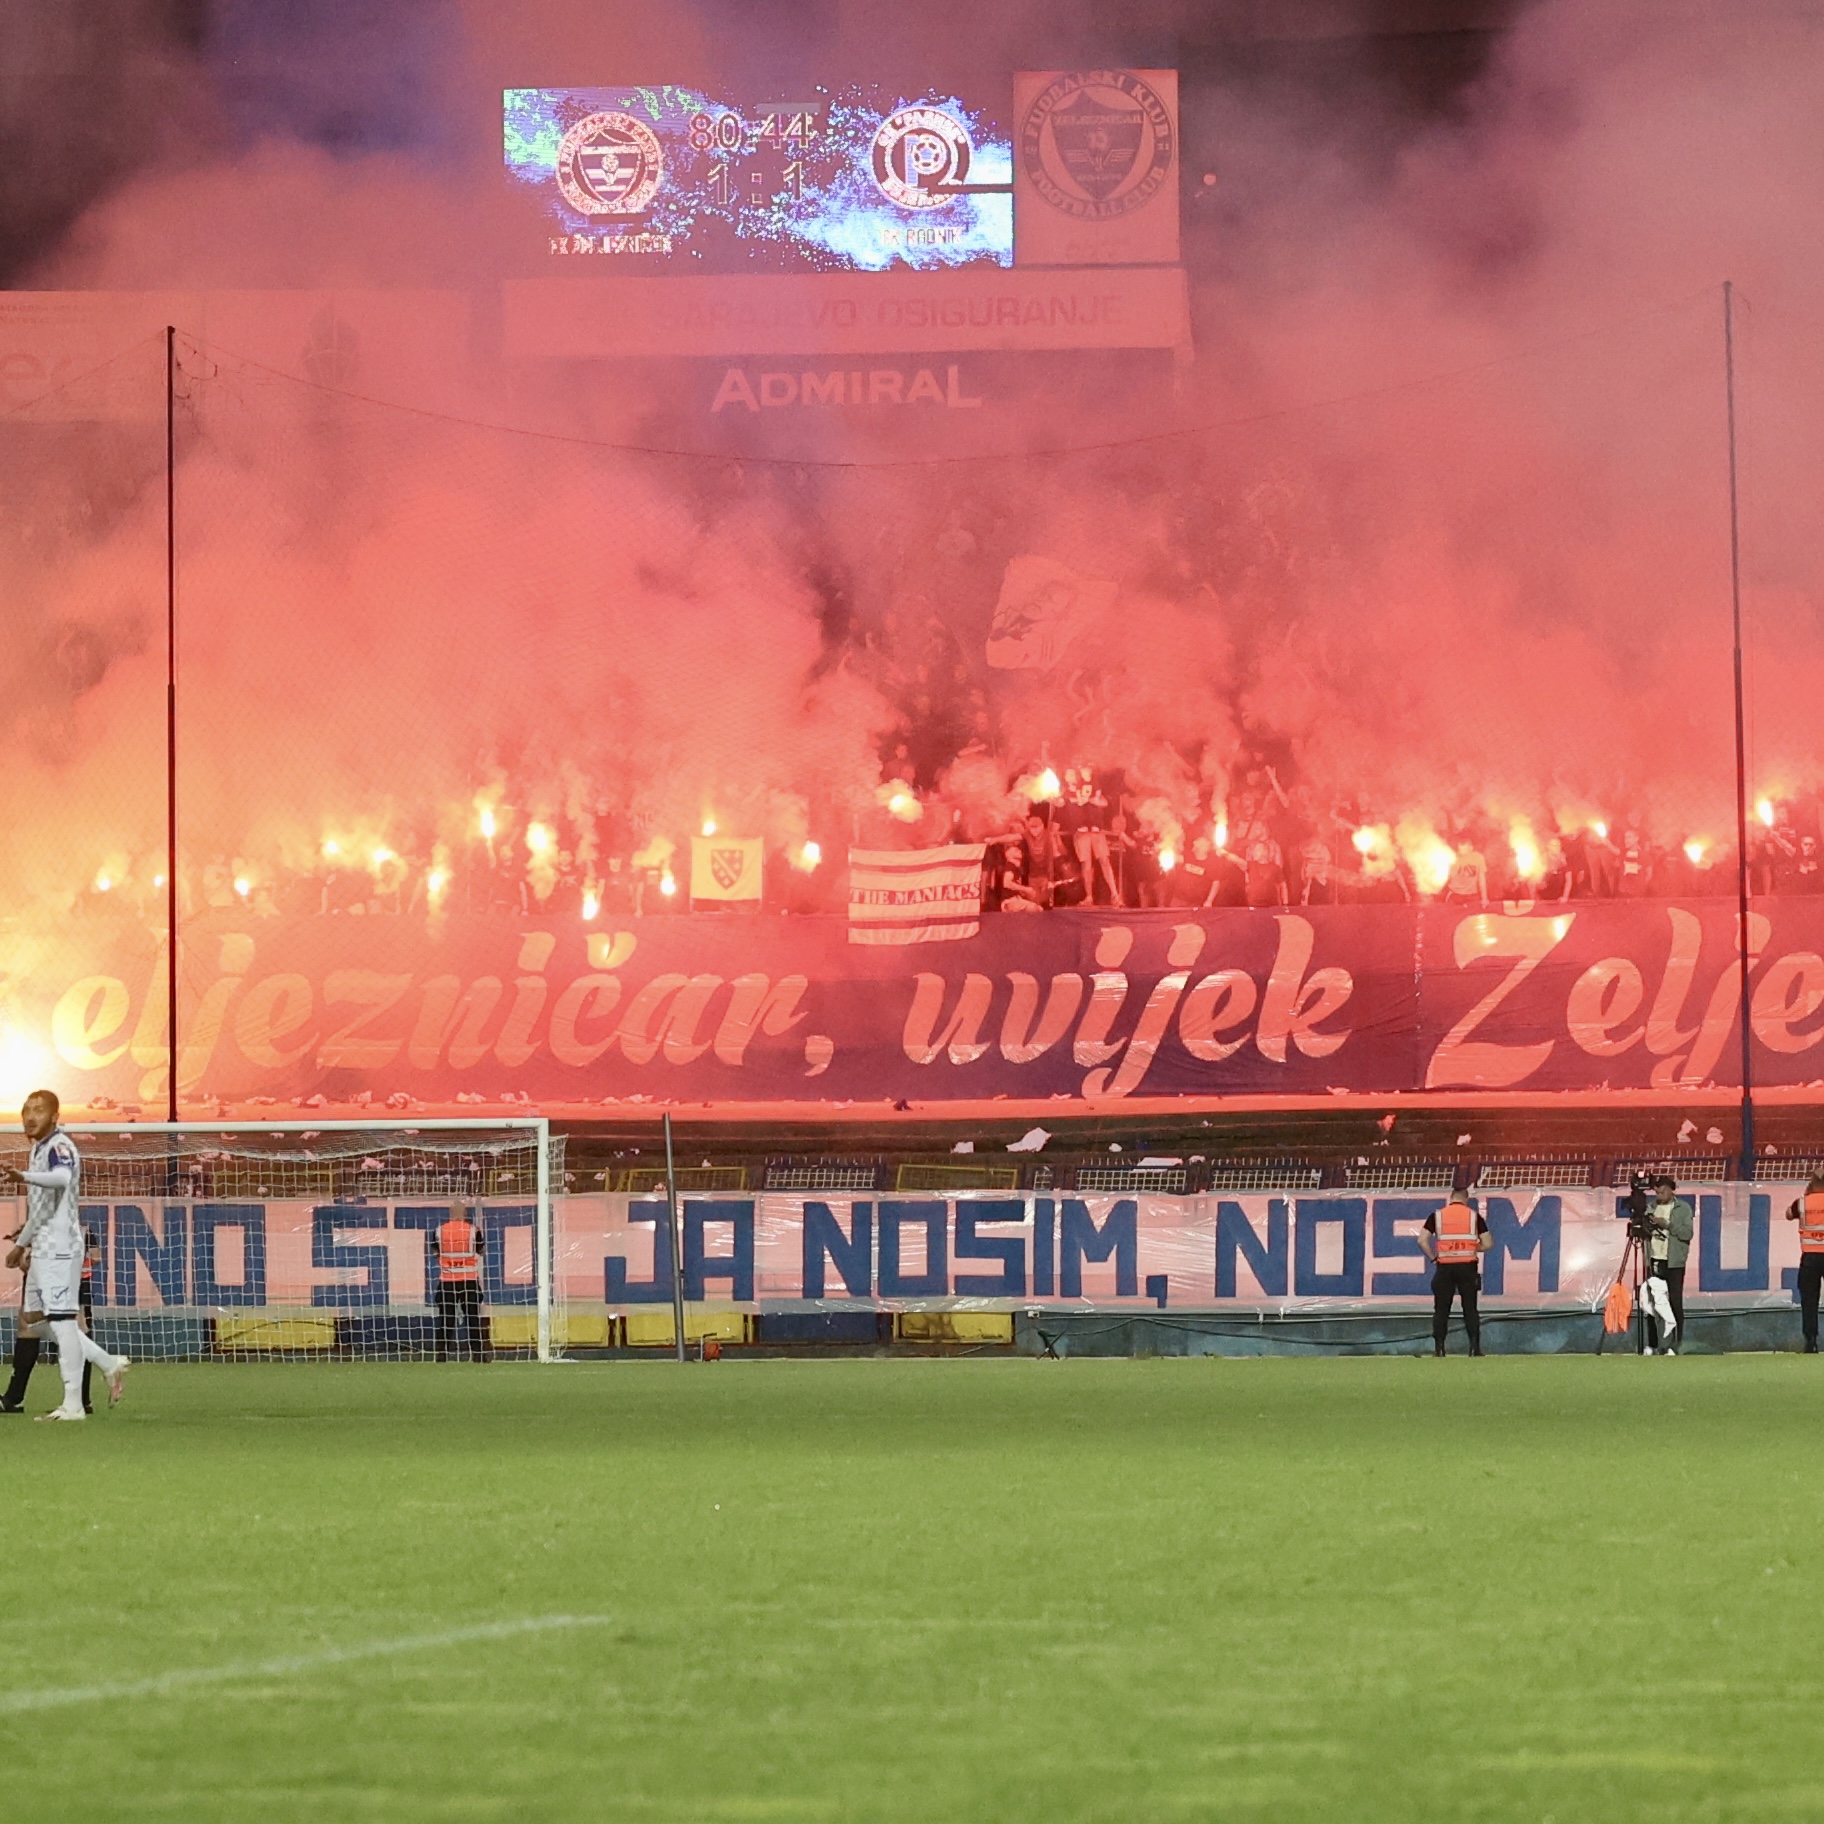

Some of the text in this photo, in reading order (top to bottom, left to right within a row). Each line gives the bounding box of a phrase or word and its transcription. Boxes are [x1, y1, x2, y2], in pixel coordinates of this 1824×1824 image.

[875, 293, 1126, 329] OSIGURANJE
[712, 365, 982, 412] ADMIRAL
[849, 882, 981, 905] THE MANIACS
[903, 914, 1353, 1099] uvijek
[603, 1199, 755, 1304] JA
[801, 1198, 1169, 1309] NOSIM,
